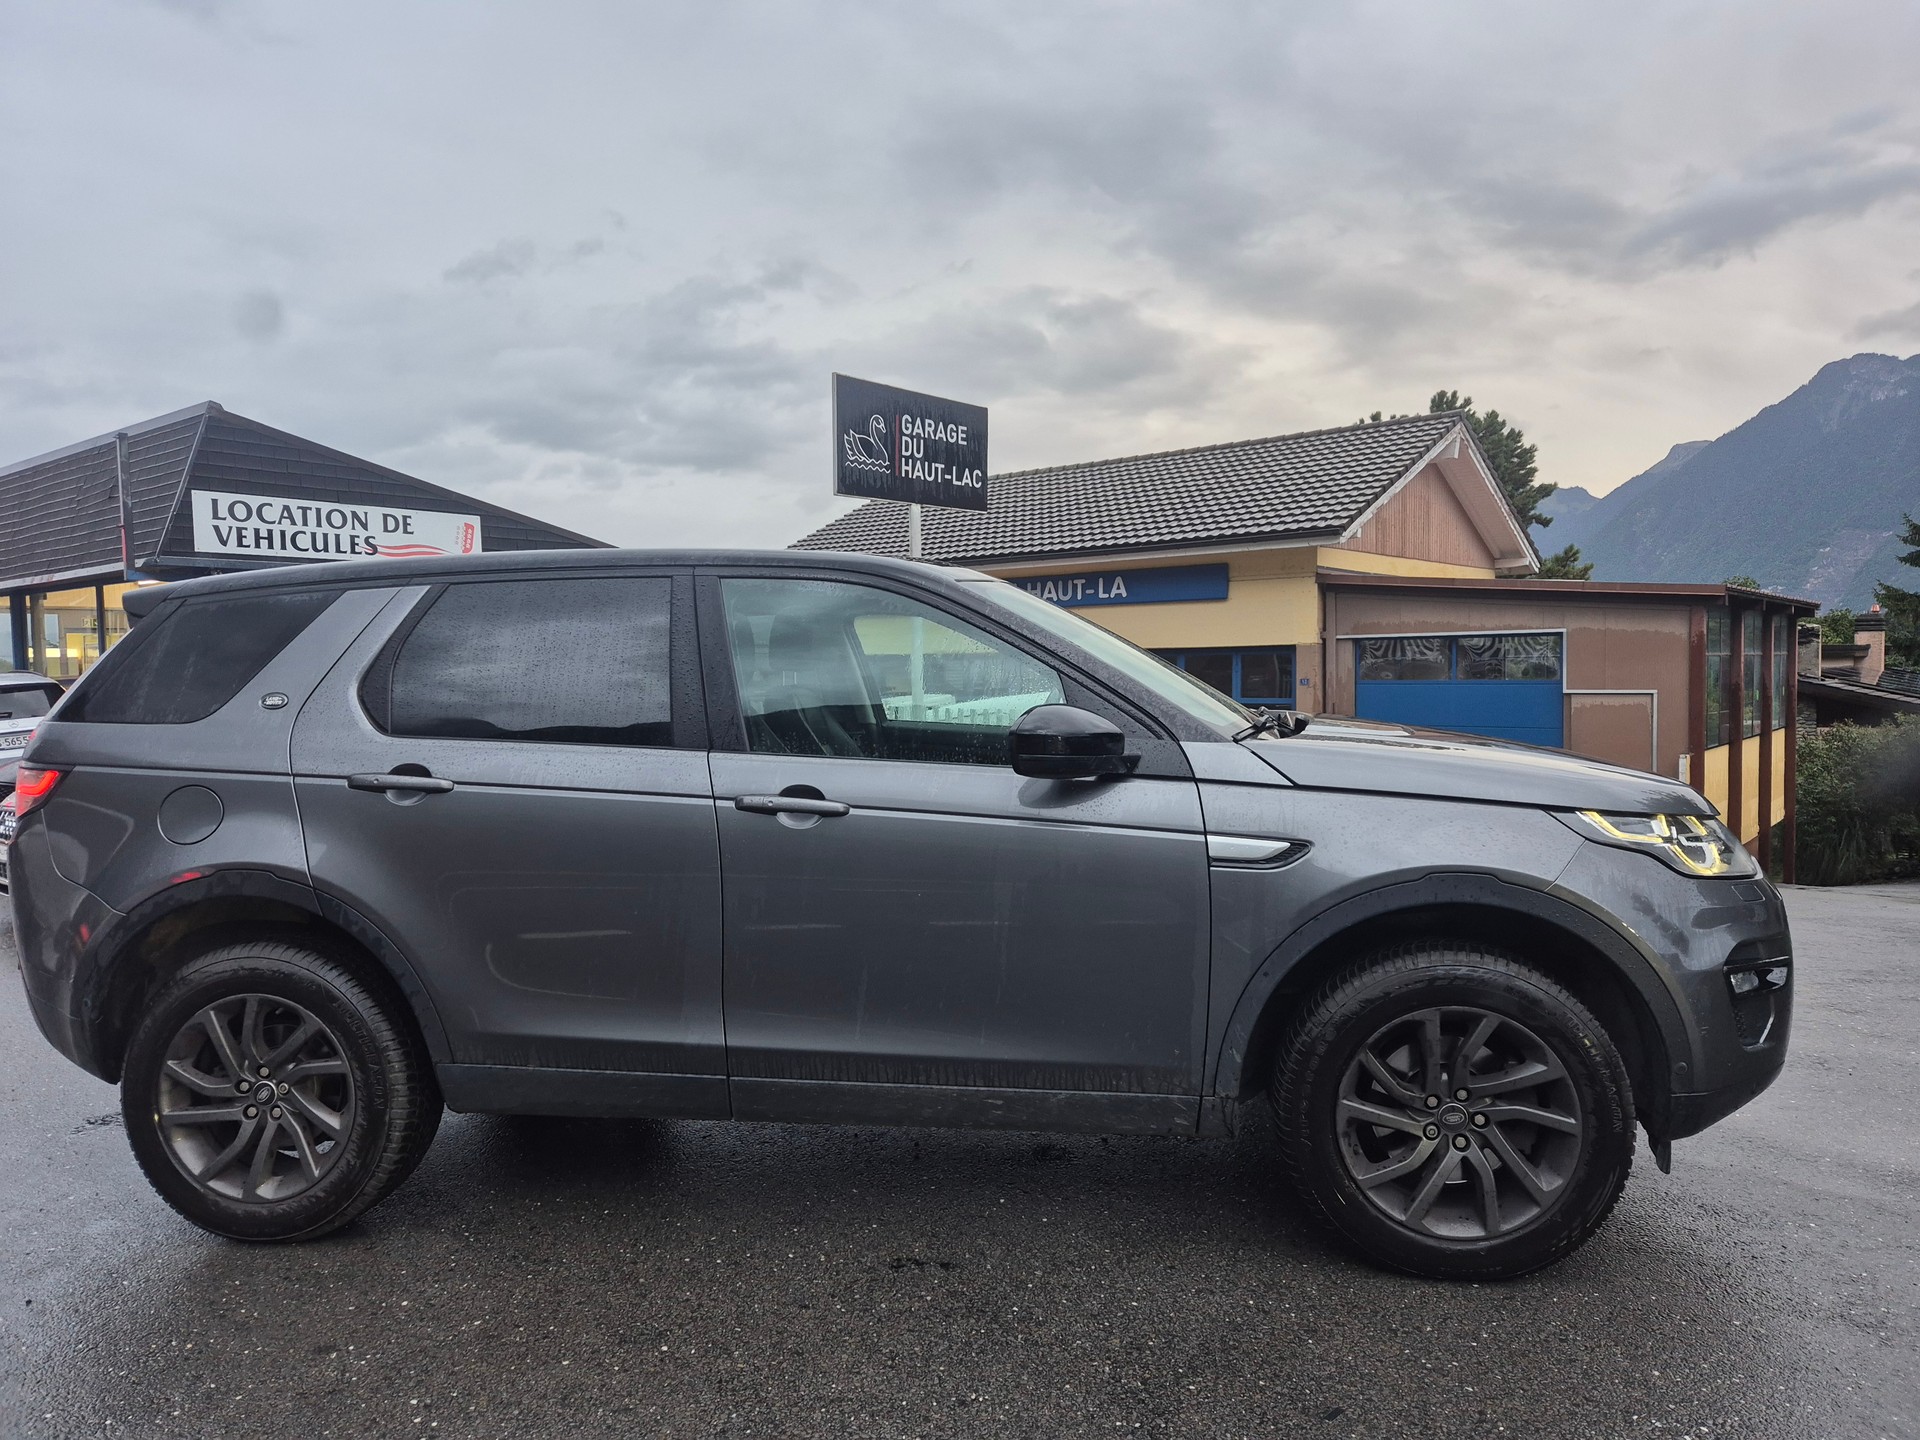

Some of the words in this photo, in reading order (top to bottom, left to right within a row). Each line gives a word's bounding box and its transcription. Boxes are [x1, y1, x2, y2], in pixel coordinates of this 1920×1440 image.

[901, 414, 967, 445] GARAGE
[901, 436, 924, 458] DU
[901, 457, 982, 488] HAUT-LAC
[210, 498, 369, 532] LOCATION
[382, 513, 415, 534] DE
[212, 524, 378, 556] VEHICULES
